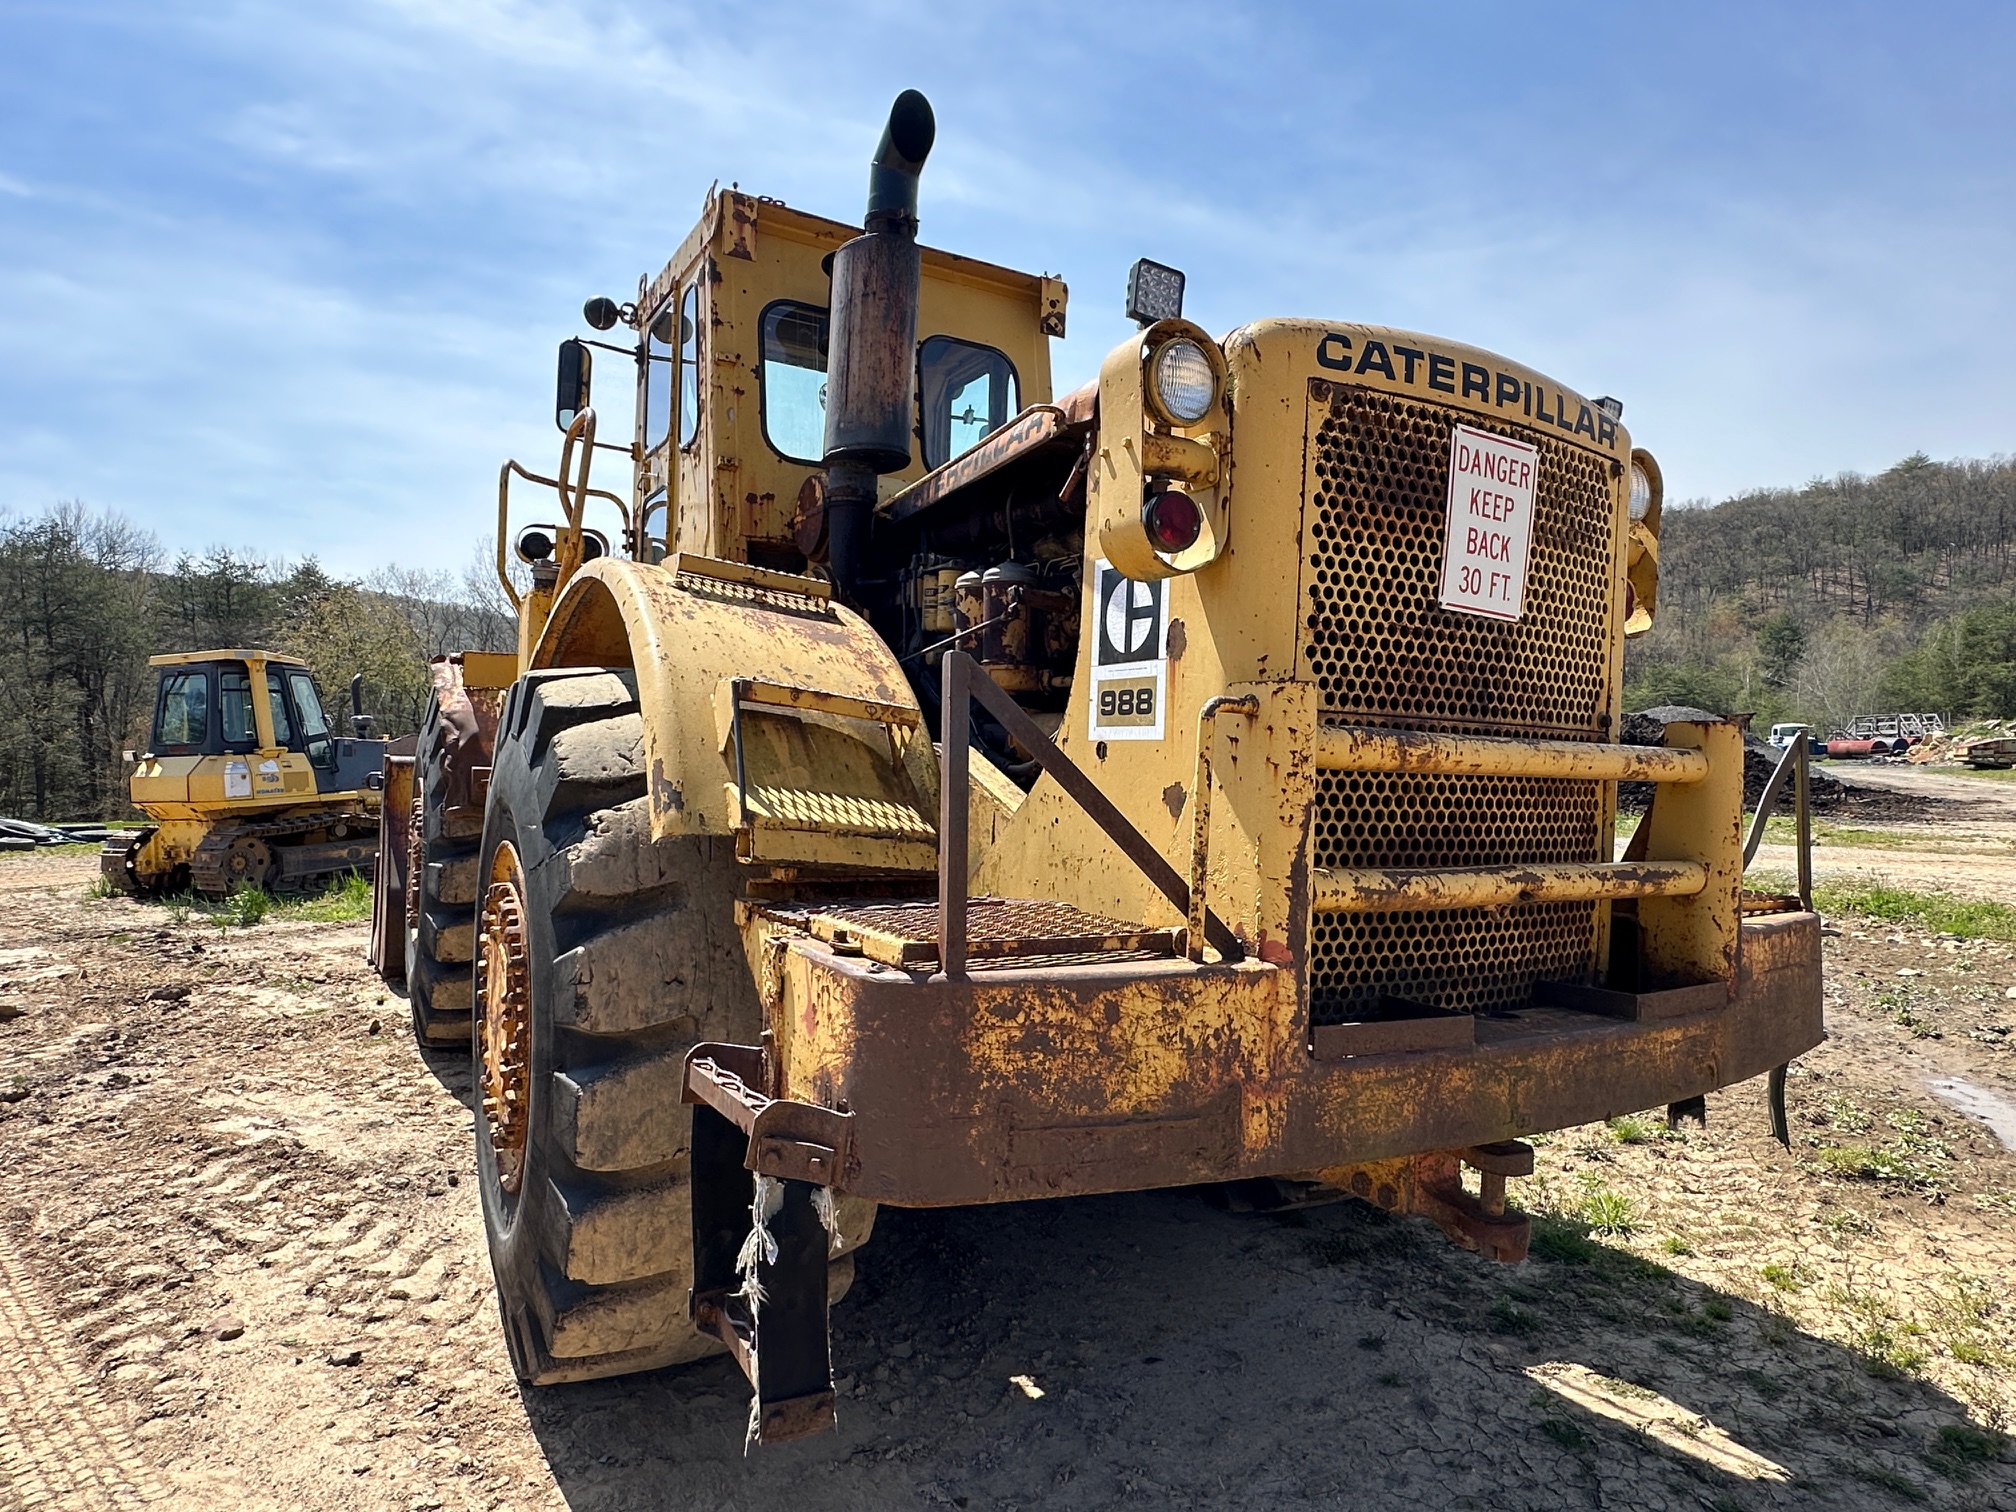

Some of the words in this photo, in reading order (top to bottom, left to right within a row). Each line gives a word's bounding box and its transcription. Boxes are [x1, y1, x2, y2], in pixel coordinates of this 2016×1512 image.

[1316, 333, 1618, 450] CATERPILLAR
[1458, 444, 1530, 490] DANGER
[1469, 489, 1515, 523] KEEP
[1466, 527, 1512, 563] BACK
[1458, 565, 1482, 595] 30
[1489, 574, 1511, 601] FT.
[1100, 688, 1153, 716] 988
